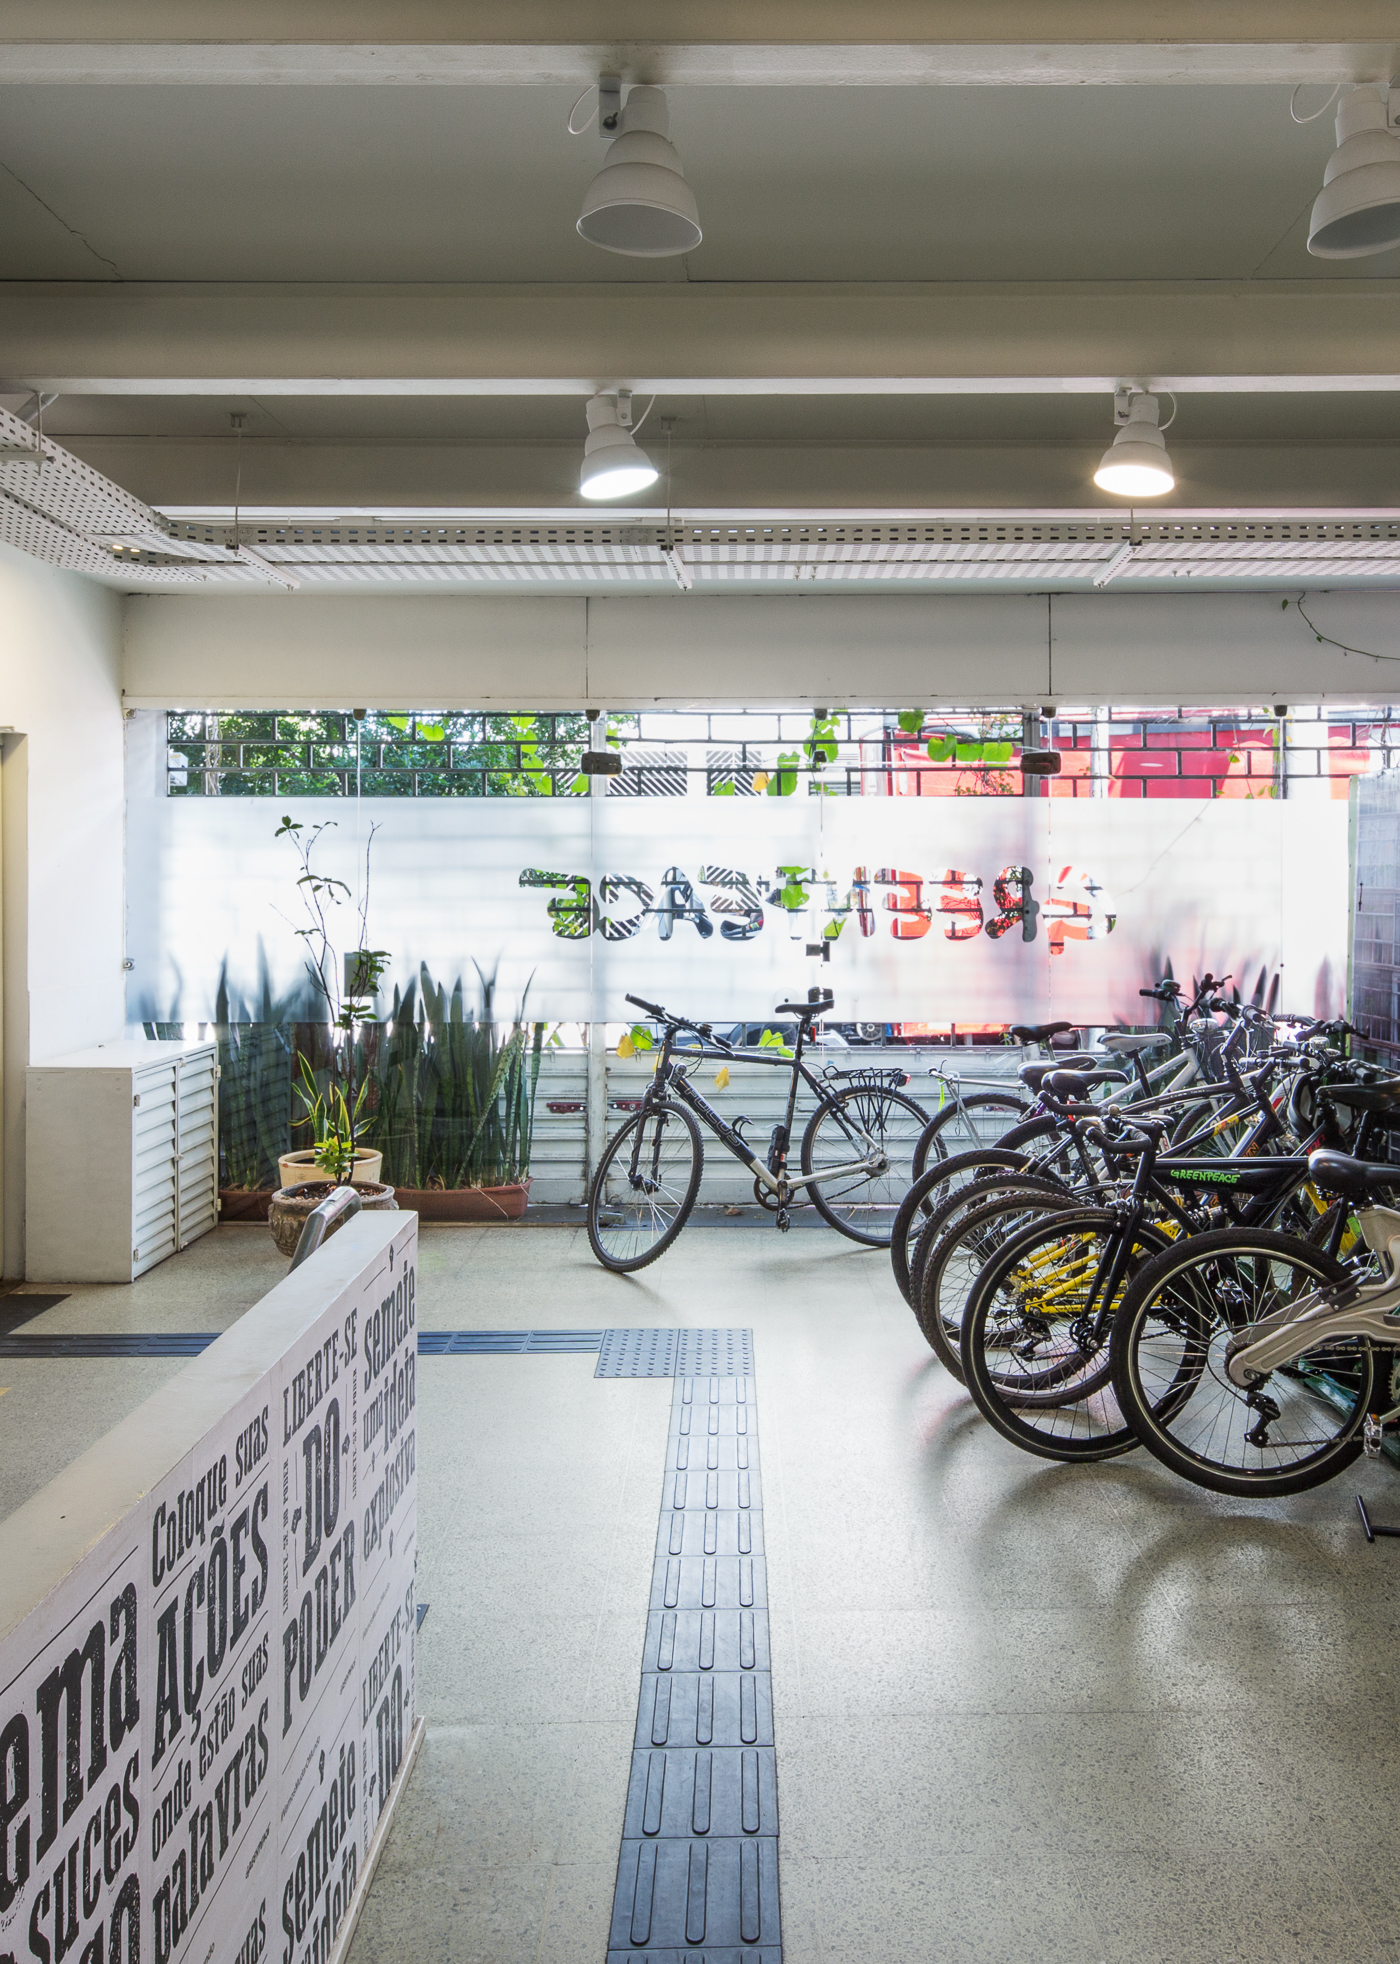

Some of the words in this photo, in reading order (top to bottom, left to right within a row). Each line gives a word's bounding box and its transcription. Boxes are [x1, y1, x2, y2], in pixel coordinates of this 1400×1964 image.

[684, 1087, 741, 1147] FOCUS
[1170, 1169, 1241, 1184] GREENPEACE
[282, 1307, 358, 1448] LIBERTE-SE
[363, 1389, 384, 1452] uma
[383, 1346, 416, 1456] ideia
[364, 1260, 415, 1394] semeie
[152, 1454, 227, 1588] Coloque
[235, 1404, 269, 1489] suas
[302, 1397, 340, 1578] DO
[363, 1428, 416, 1562] explosiva
[152, 1480, 269, 1773] AÇÕES
[282, 1519, 356, 1740] PODER
[362, 1578, 415, 1730] LIBERTE-SE
[152, 1759, 192, 1863] onde
[199, 1686, 236, 1782] estão
[241, 1631, 269, 1712] suas
[376, 1663, 402, 1822] DO
[152, 1697, 269, 1964] palavras
[282, 1740, 357, 1964] semeie
